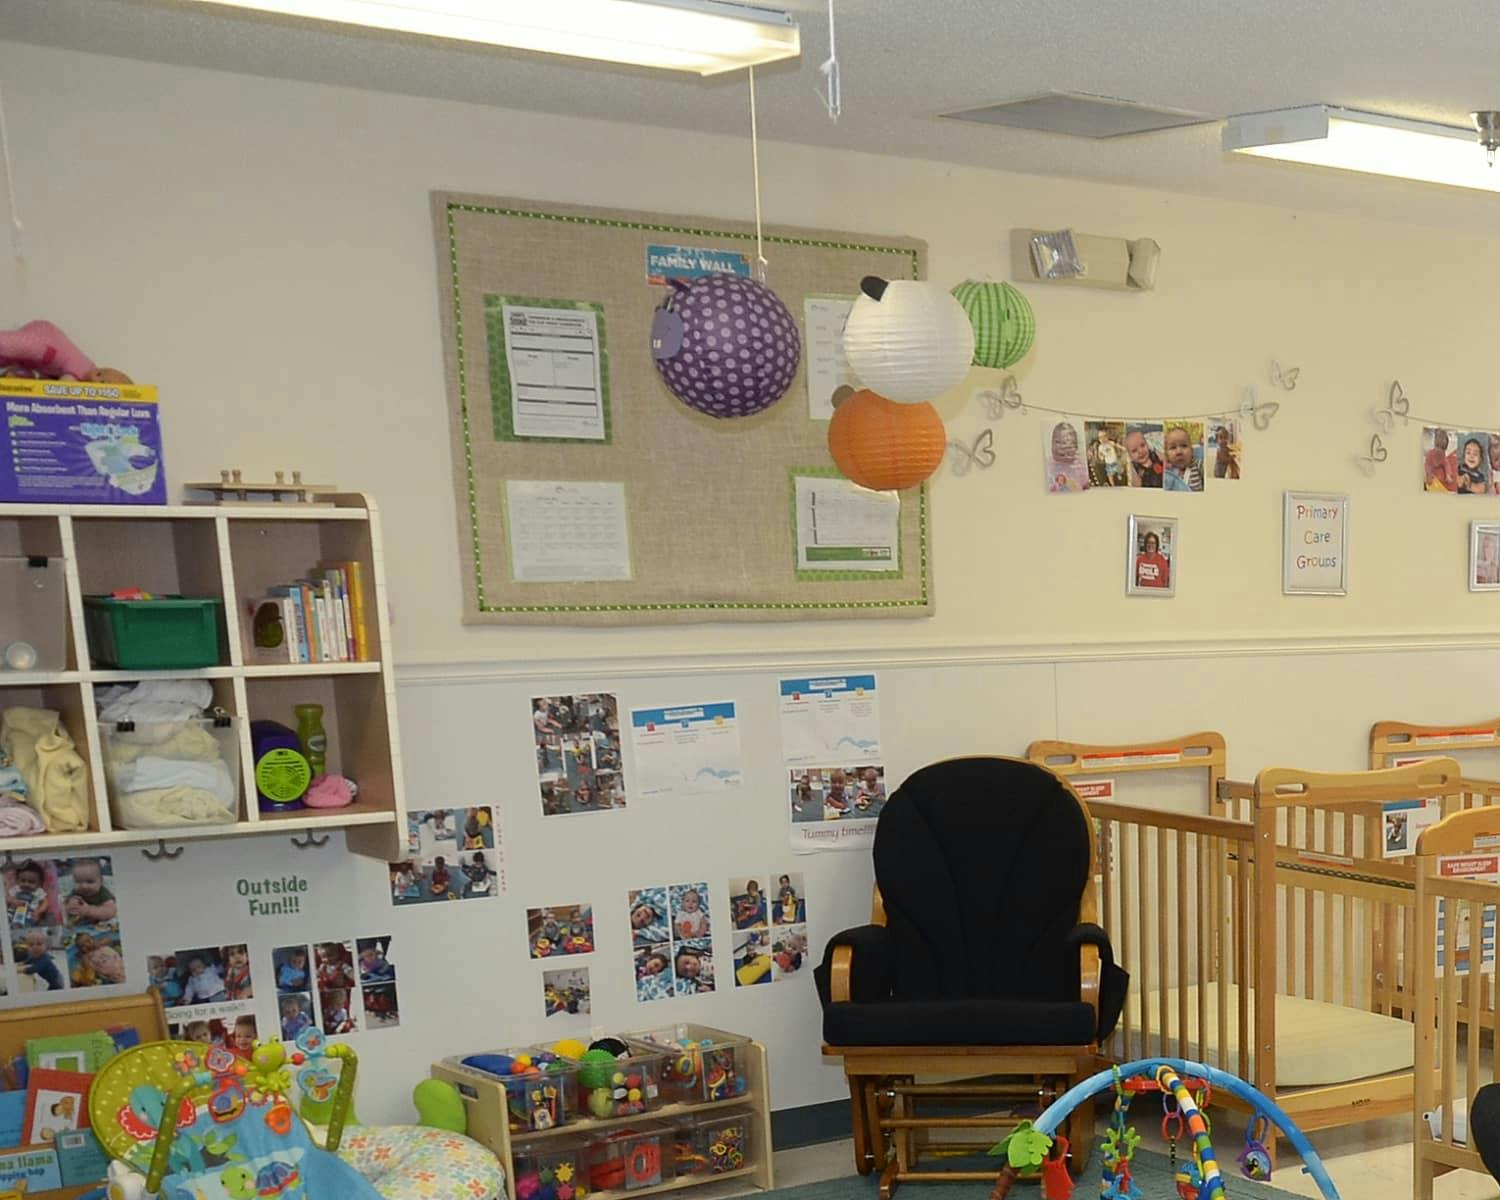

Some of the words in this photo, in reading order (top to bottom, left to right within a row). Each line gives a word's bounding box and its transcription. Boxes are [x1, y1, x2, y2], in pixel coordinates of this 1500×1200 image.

[650, 255, 698, 270] FAMILY
[700, 260, 737, 274] WALL
[1296, 505, 1338, 519] Primary
[1304, 530, 1331, 545] Care
[1296, 555, 1337, 570] Groups
[801, 828, 840, 841] Tummy
[237, 876, 308, 896] Outside
[249, 896, 300, 916] Fun!!!
